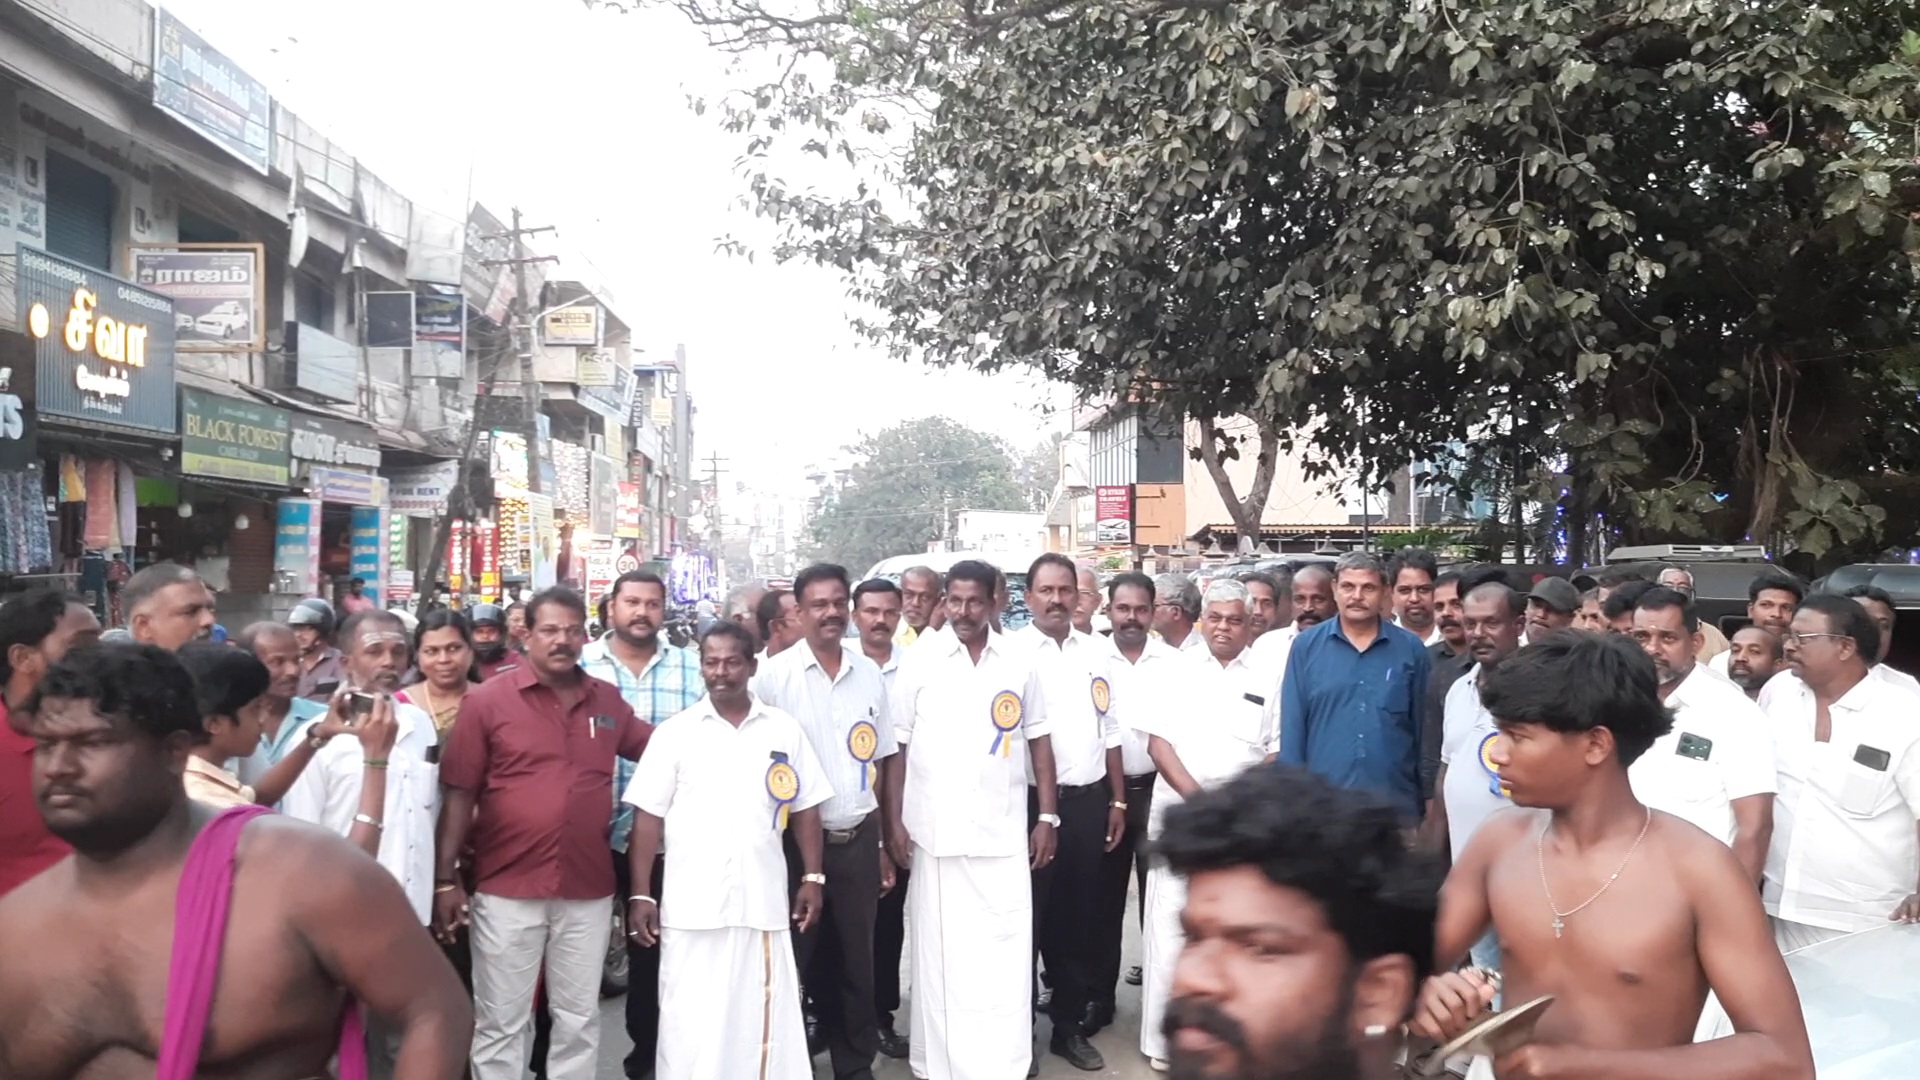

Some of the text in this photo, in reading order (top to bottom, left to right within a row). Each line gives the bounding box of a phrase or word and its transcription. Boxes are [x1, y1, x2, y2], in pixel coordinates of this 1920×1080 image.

[186, 413, 236, 443] BLACK
[238, 424, 288, 452] FOREST
[416, 487, 441, 496] RENT
[619, 561, 636, 571] 30
